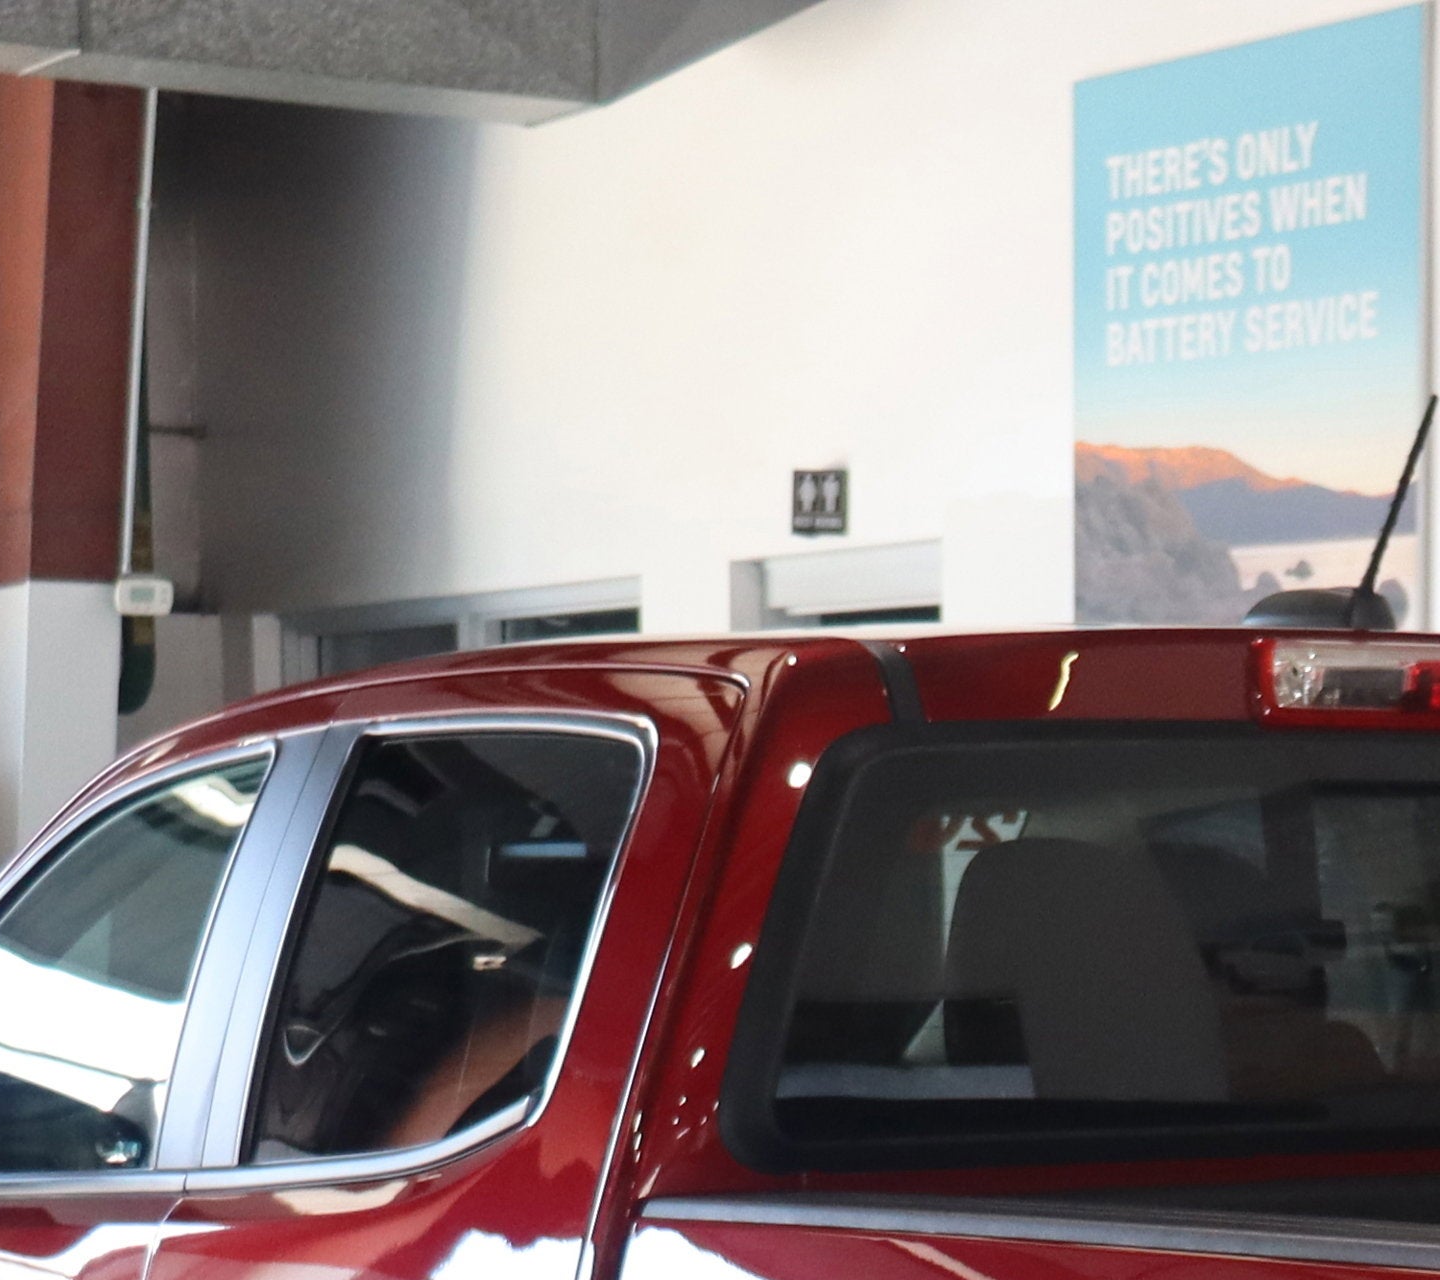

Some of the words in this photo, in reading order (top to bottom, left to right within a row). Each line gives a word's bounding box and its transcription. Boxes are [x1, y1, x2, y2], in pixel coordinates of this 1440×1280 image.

[1105, 137, 1228, 200] THERE'S
[1236, 120, 1319, 181] ONLY
[1106, 191, 1261, 256] POSITIVES
[1269, 171, 1368, 233] WHEN
[1105, 265, 1133, 311] IT
[1139, 251, 1244, 308] COMES
[1252, 244, 1291, 292] TO
[1105, 308, 1237, 367] BATTERY
[1244, 290, 1379, 353] SERVICE
